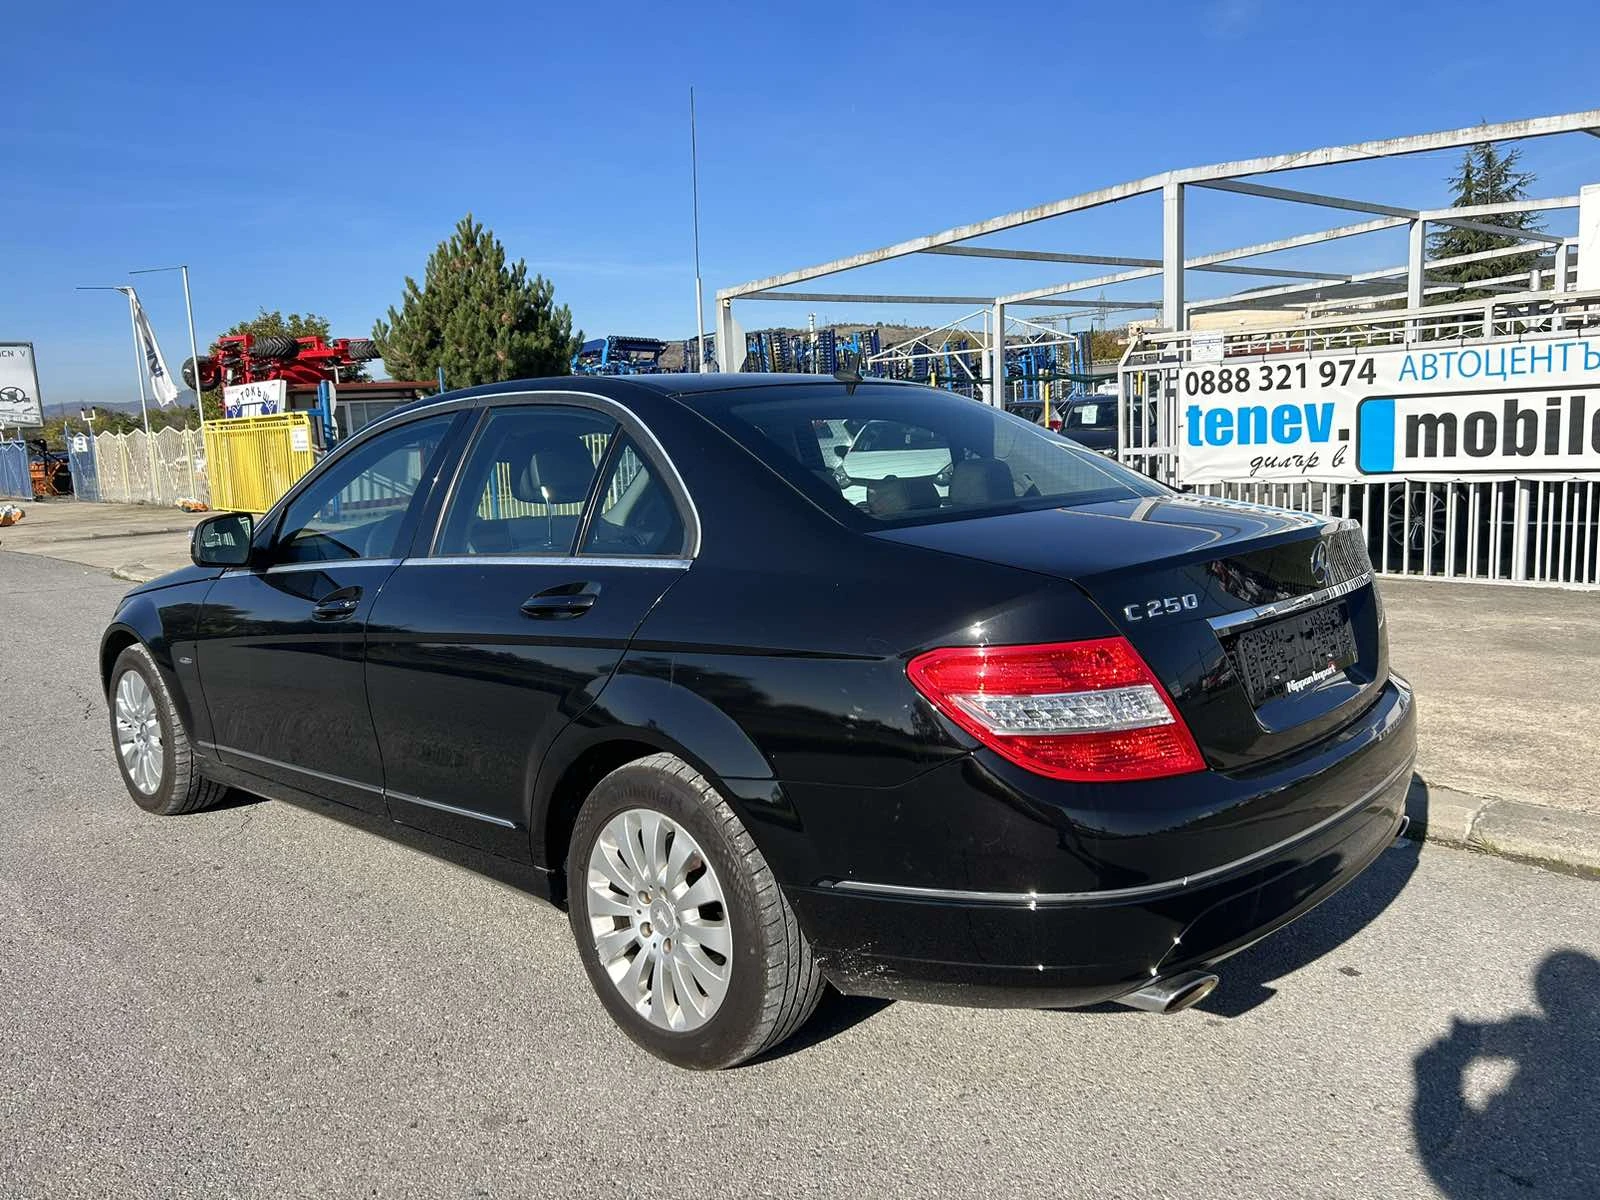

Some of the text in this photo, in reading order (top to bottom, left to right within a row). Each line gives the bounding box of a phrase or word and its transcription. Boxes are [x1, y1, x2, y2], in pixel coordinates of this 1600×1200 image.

[1185, 358, 1377, 396] 0888 321 974
[1398, 341, 1600, 381] АВТОЦЕНТЪ
[1250, 450, 1320, 477] дилър
[1124, 593, 1199, 621] C 250
